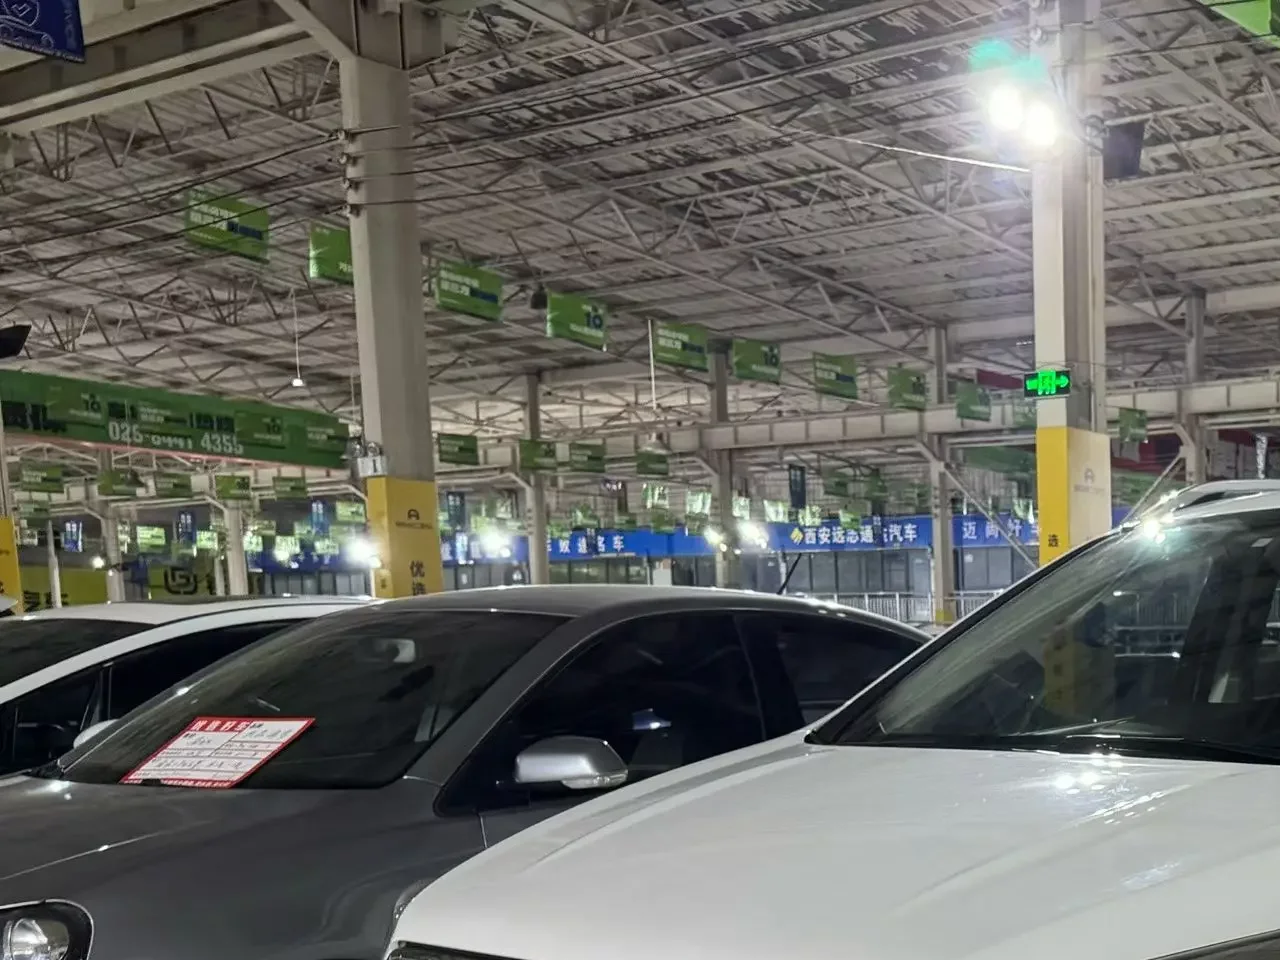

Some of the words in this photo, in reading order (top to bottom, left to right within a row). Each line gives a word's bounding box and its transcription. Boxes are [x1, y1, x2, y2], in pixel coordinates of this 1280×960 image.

[804, 522, 917, 545] 西安远志通汽车
